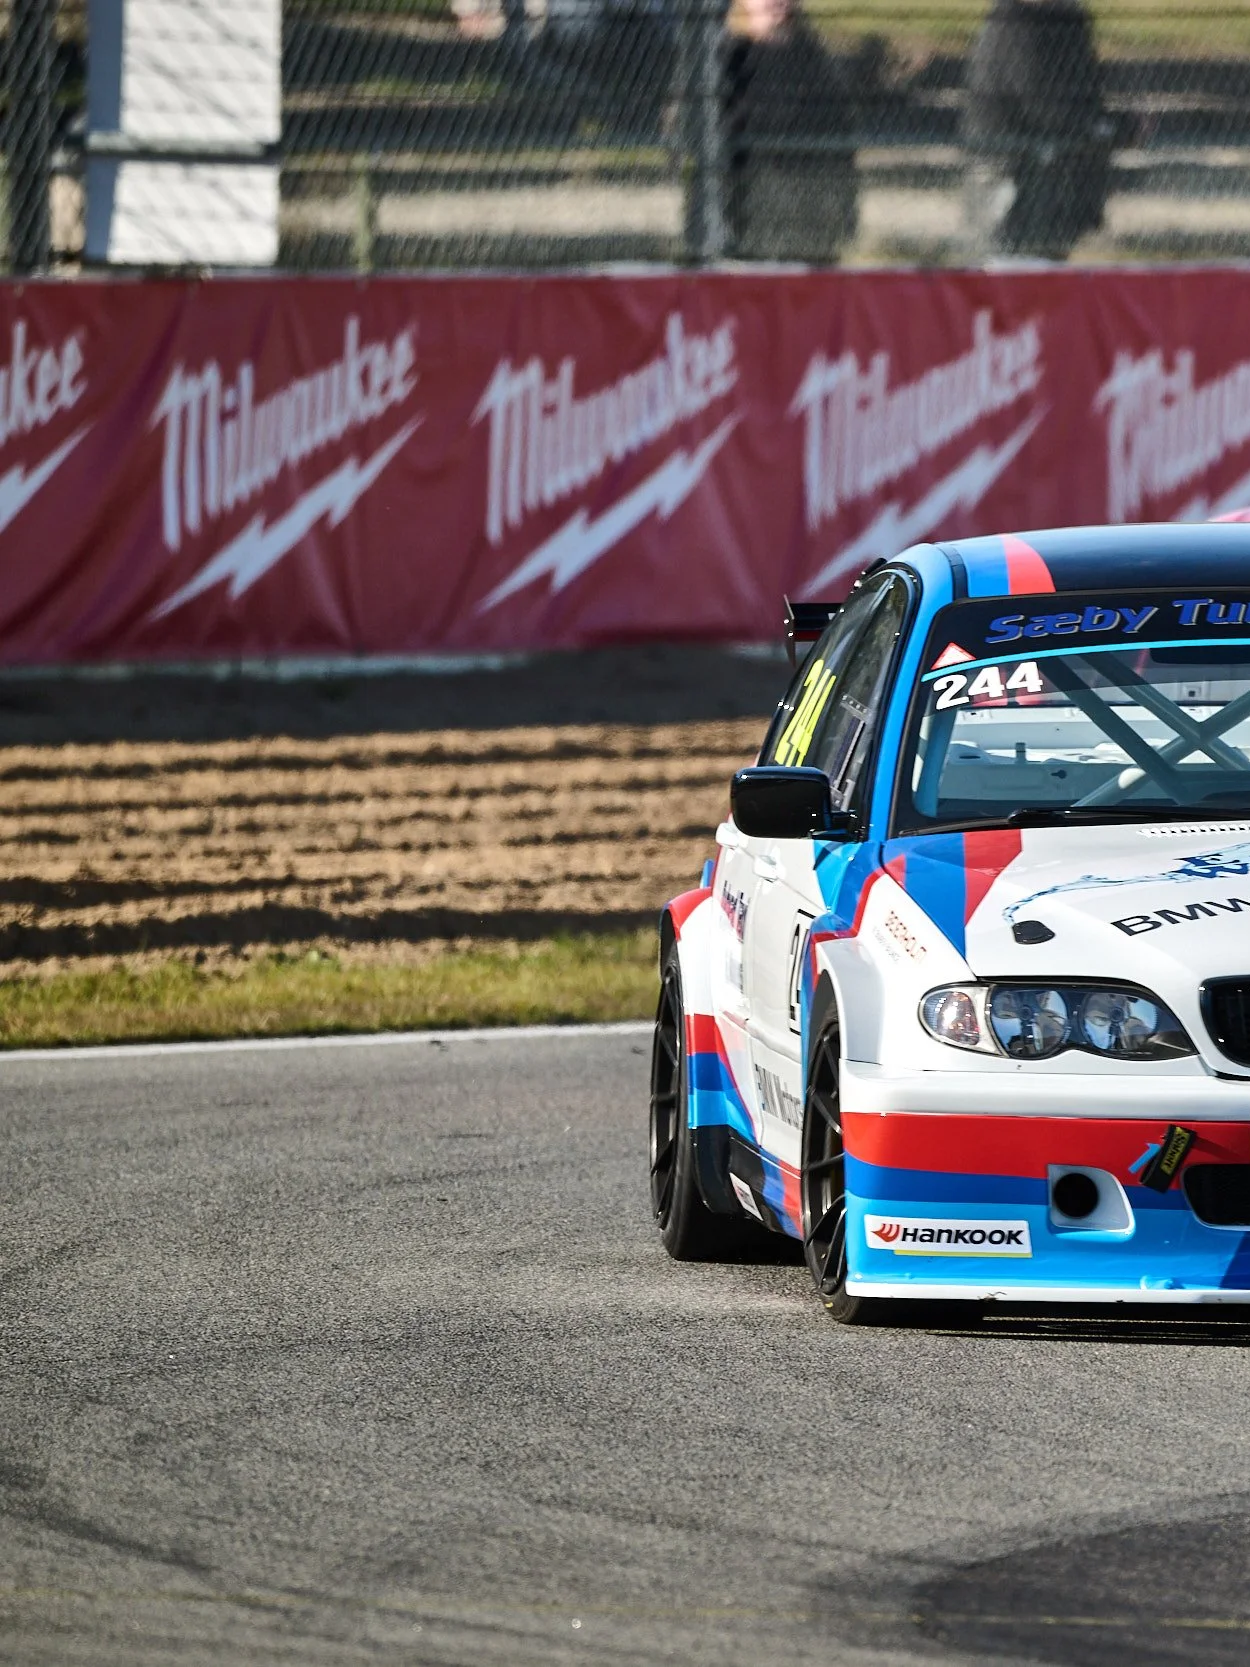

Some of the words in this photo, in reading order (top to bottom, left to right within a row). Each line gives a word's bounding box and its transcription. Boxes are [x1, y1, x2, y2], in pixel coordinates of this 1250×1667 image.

[150, 314, 418, 552] Milwaukee
[470, 311, 740, 547] Milwaukee
[788, 309, 1048, 532] Milwaukee
[932, 661, 1043, 710] 244
[985, 605, 1158, 644] Sæby
